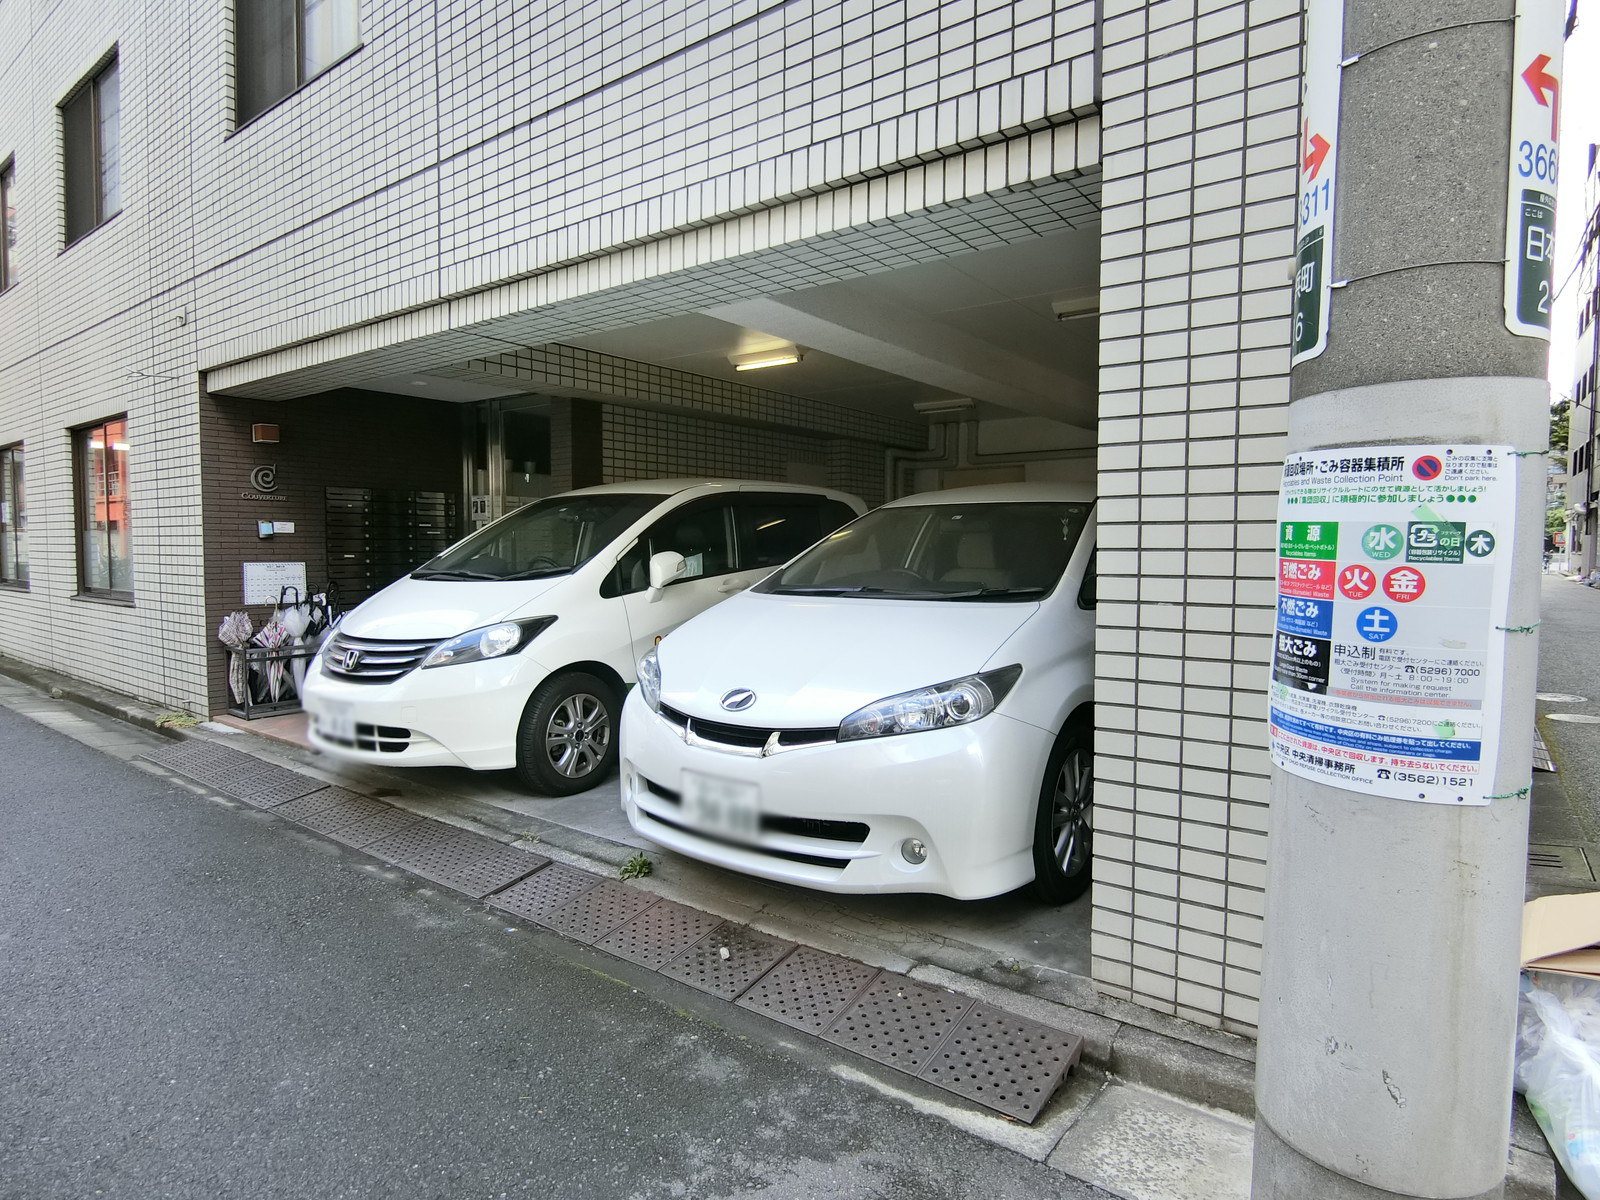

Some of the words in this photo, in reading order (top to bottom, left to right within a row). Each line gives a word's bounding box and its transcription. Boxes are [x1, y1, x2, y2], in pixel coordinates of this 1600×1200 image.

[1311, 476, 1332, 484] Waste
[1334, 473, 1375, 483] Collection
[1378, 474, 1403, 482] Point
[1368, 527, 1396, 550] 水
[1440, 537, 1460, 547] の日
[1470, 534, 1490, 554] 木
[1282, 562, 1321, 580] 可燃ごみ
[1344, 568, 1370, 591] 火
[1389, 570, 1419, 593] 金
[1280, 598, 1318, 618] 不燃ごみ
[1363, 610, 1390, 632] 土
[1334, 644, 1376, 660] 申込制
[1351, 677, 1378, 686] System
[1392, 682, 1420, 690] making
[1380, 687, 1421, 696] information
[1292, 749, 1355, 774] 中央清掃事務所
[1316, 767, 1350, 780] COLLECTION
[1352, 776, 1374, 784] OFFICE
[1394, 772, 1473, 786] (3562)1521
